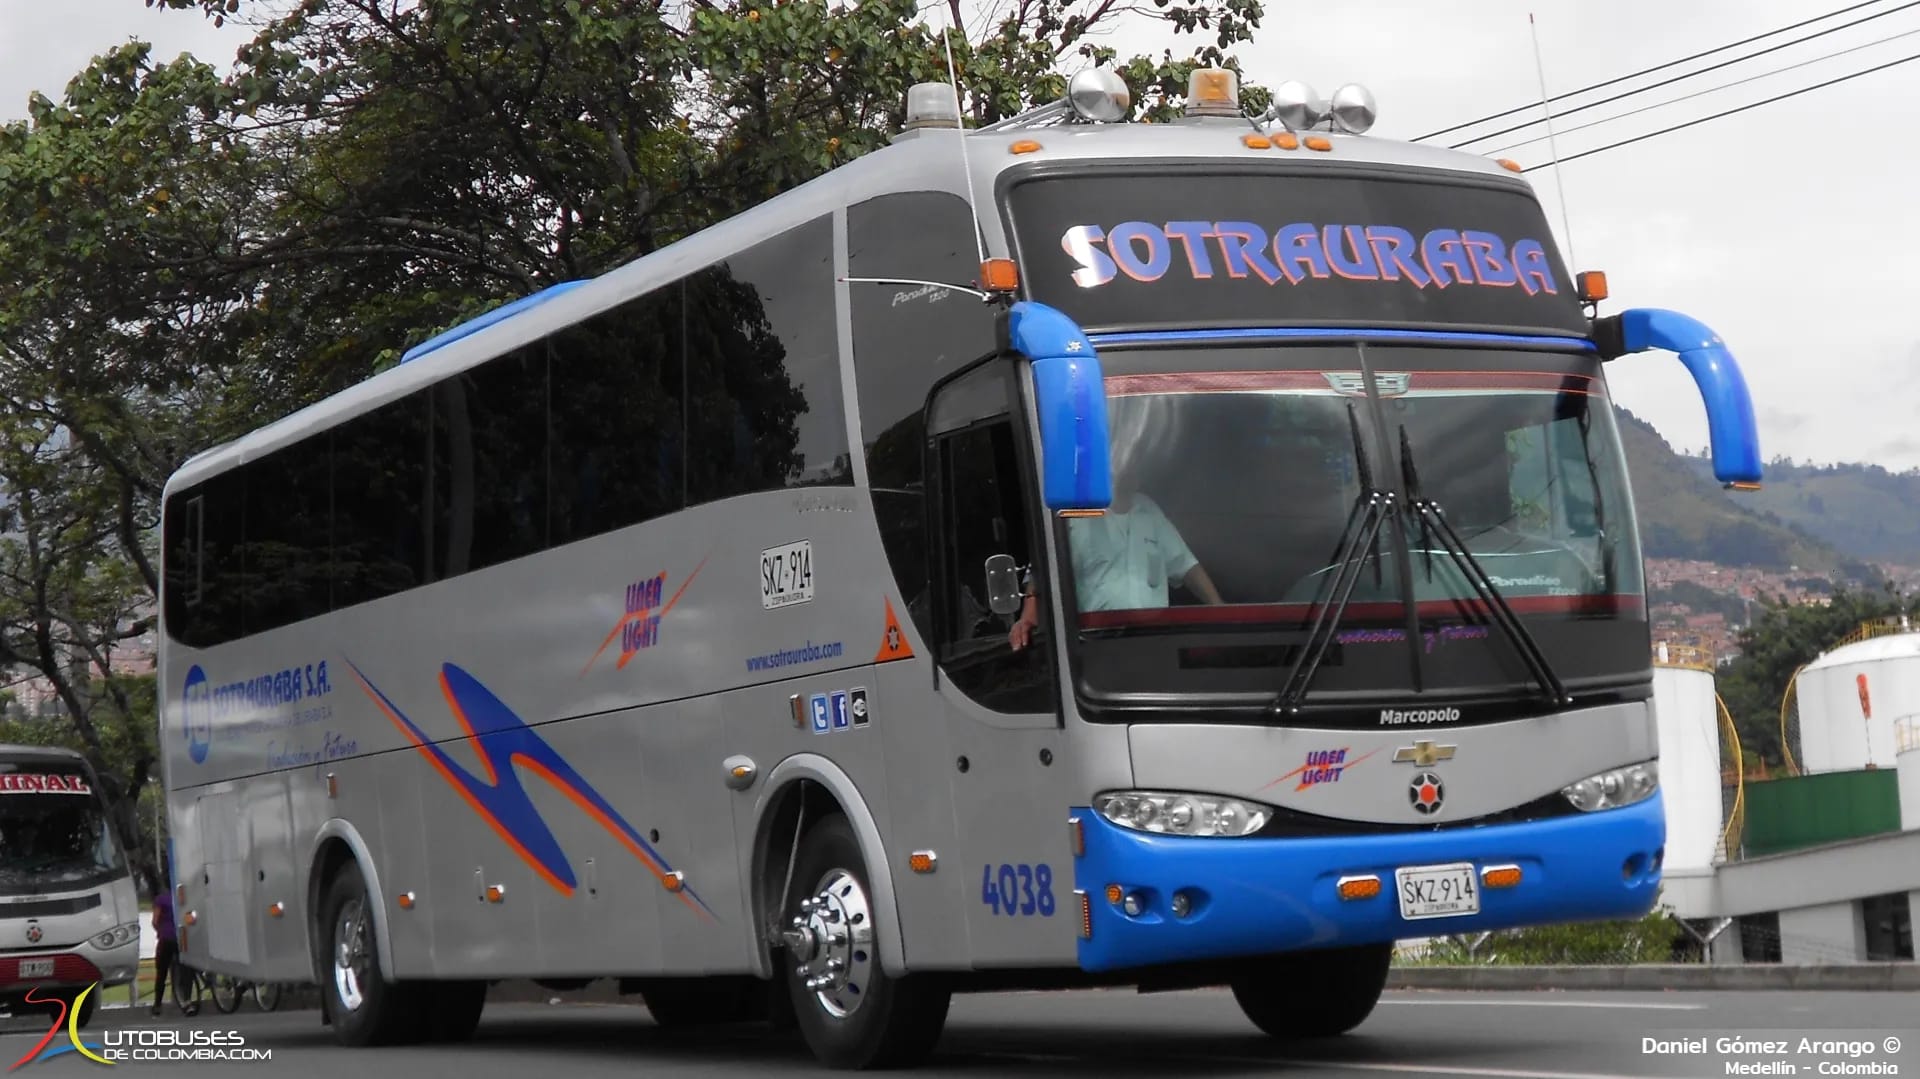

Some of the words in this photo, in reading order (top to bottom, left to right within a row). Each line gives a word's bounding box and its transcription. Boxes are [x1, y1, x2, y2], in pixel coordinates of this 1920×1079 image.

[1061, 220, 1558, 296] SOTRAURABA
[622, 615, 661, 653] LIGHT
[1380, 707, 1461, 725] Marcopolo
[1306, 749, 1347, 766] LINEA
[1302, 767, 1345, 784] LIGHT
[982, 863, 1055, 917] 4038
